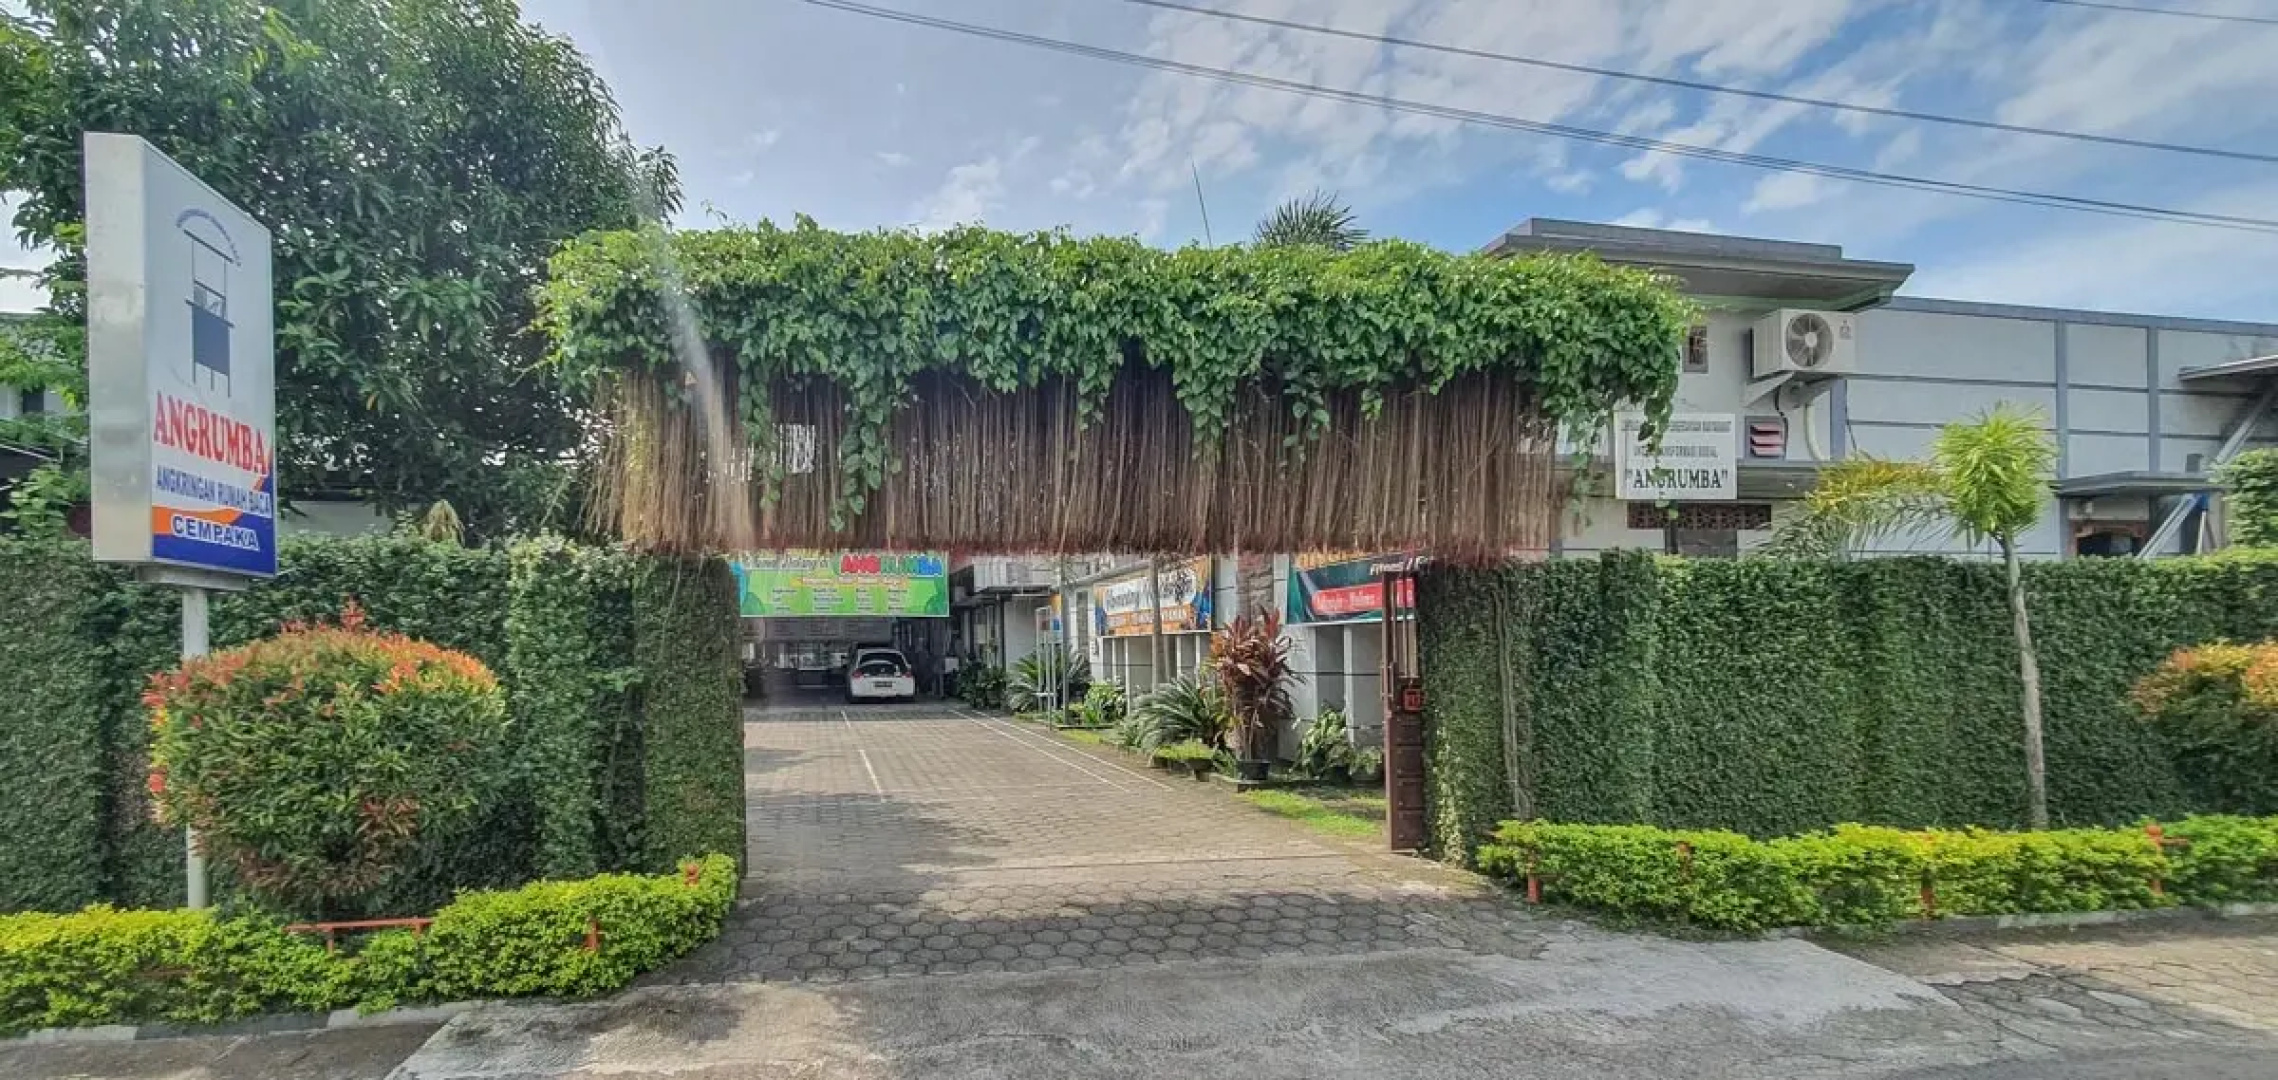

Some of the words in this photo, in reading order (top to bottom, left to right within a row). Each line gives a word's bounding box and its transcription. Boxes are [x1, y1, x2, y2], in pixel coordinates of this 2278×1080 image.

[154, 390, 268, 474] ANGRUMBA
[156, 465, 215, 502] ANGKRINGAN
[217, 484, 247, 509] RUMAH
[249, 491, 271, 517] BACA
[171, 514, 259, 550] CEMPAKA
